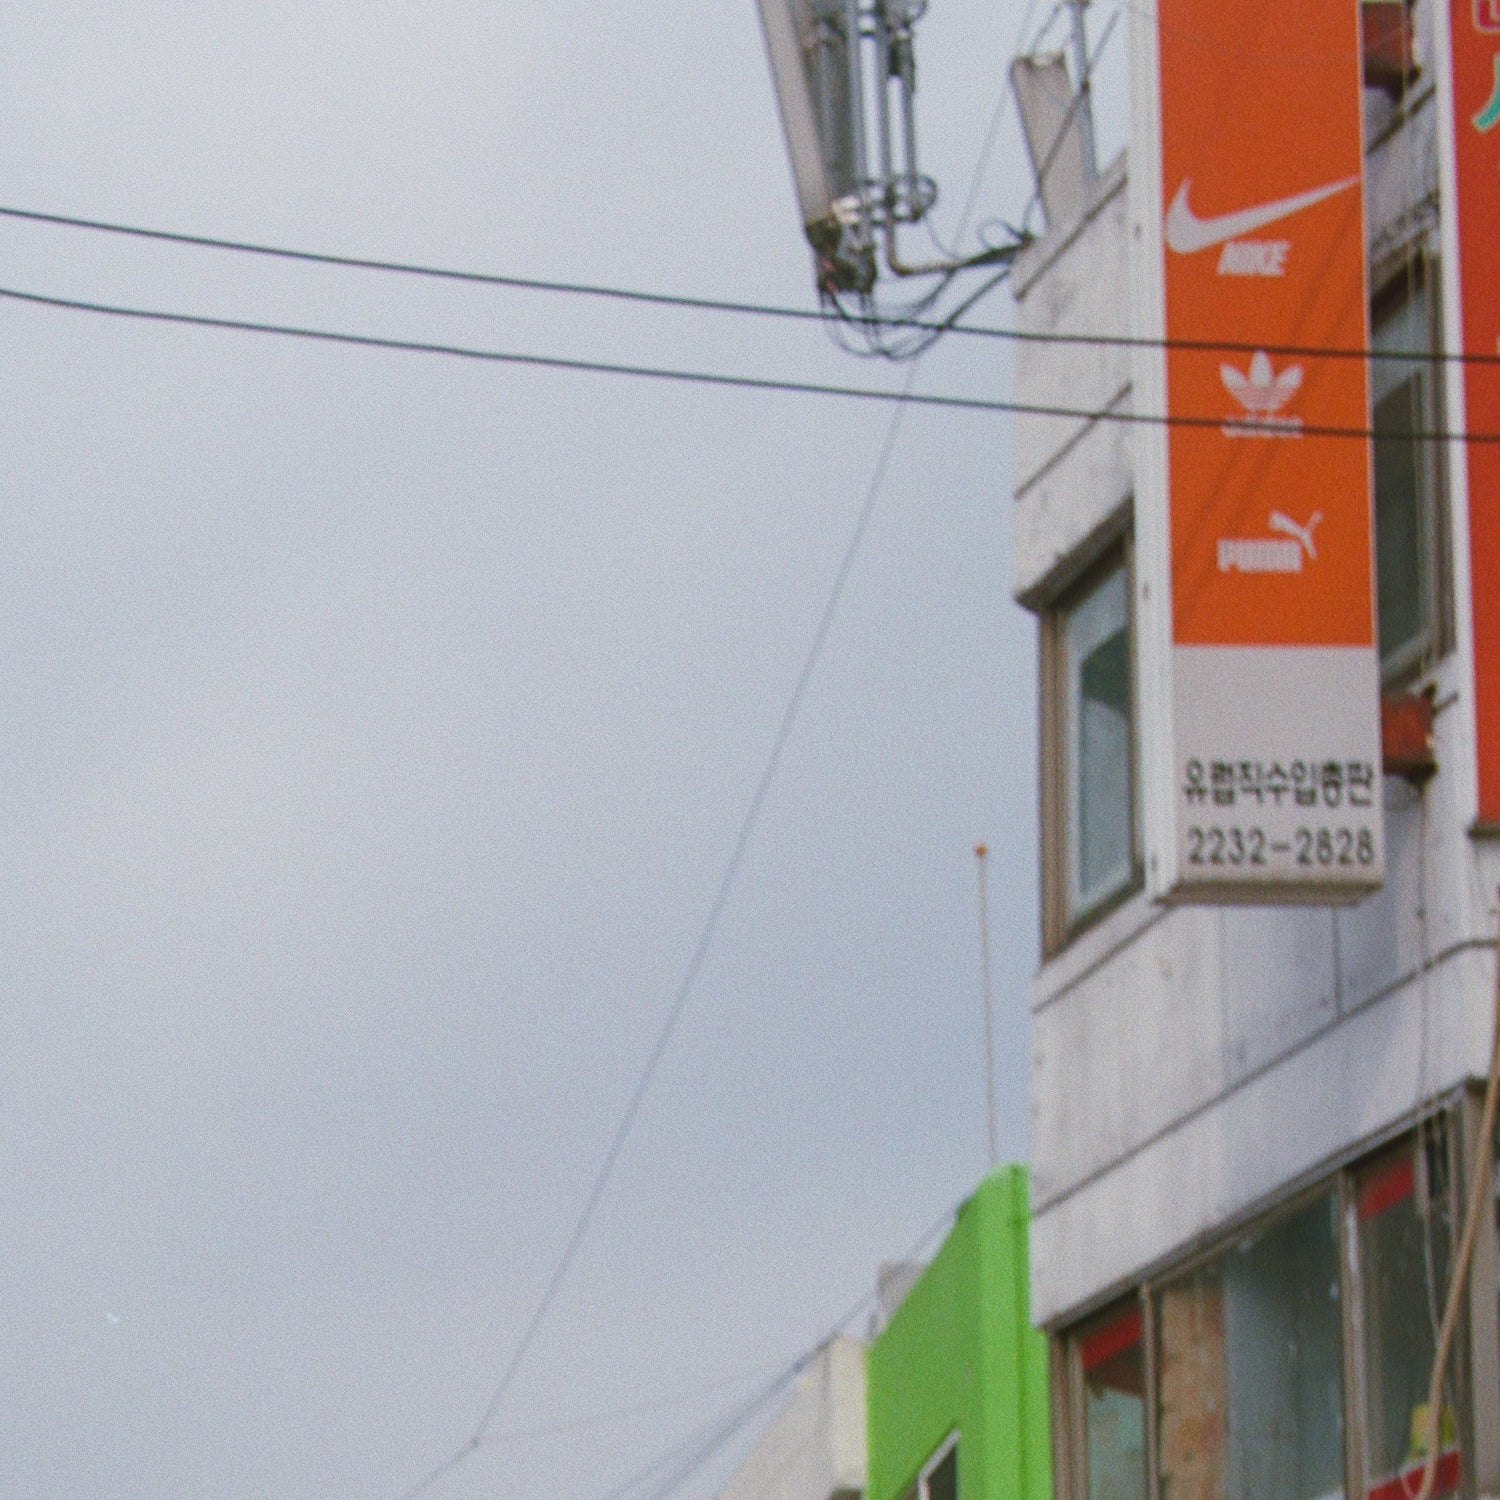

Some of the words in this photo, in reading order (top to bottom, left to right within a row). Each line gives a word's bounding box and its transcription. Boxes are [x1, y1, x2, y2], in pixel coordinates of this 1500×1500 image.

[1217, 239, 1290, 277] NIKE
[1217, 537, 1302, 573] PUMA
[1184, 756, 1374, 808] 유럽직수입총판
[1188, 826, 1375, 866] 2232-2828
